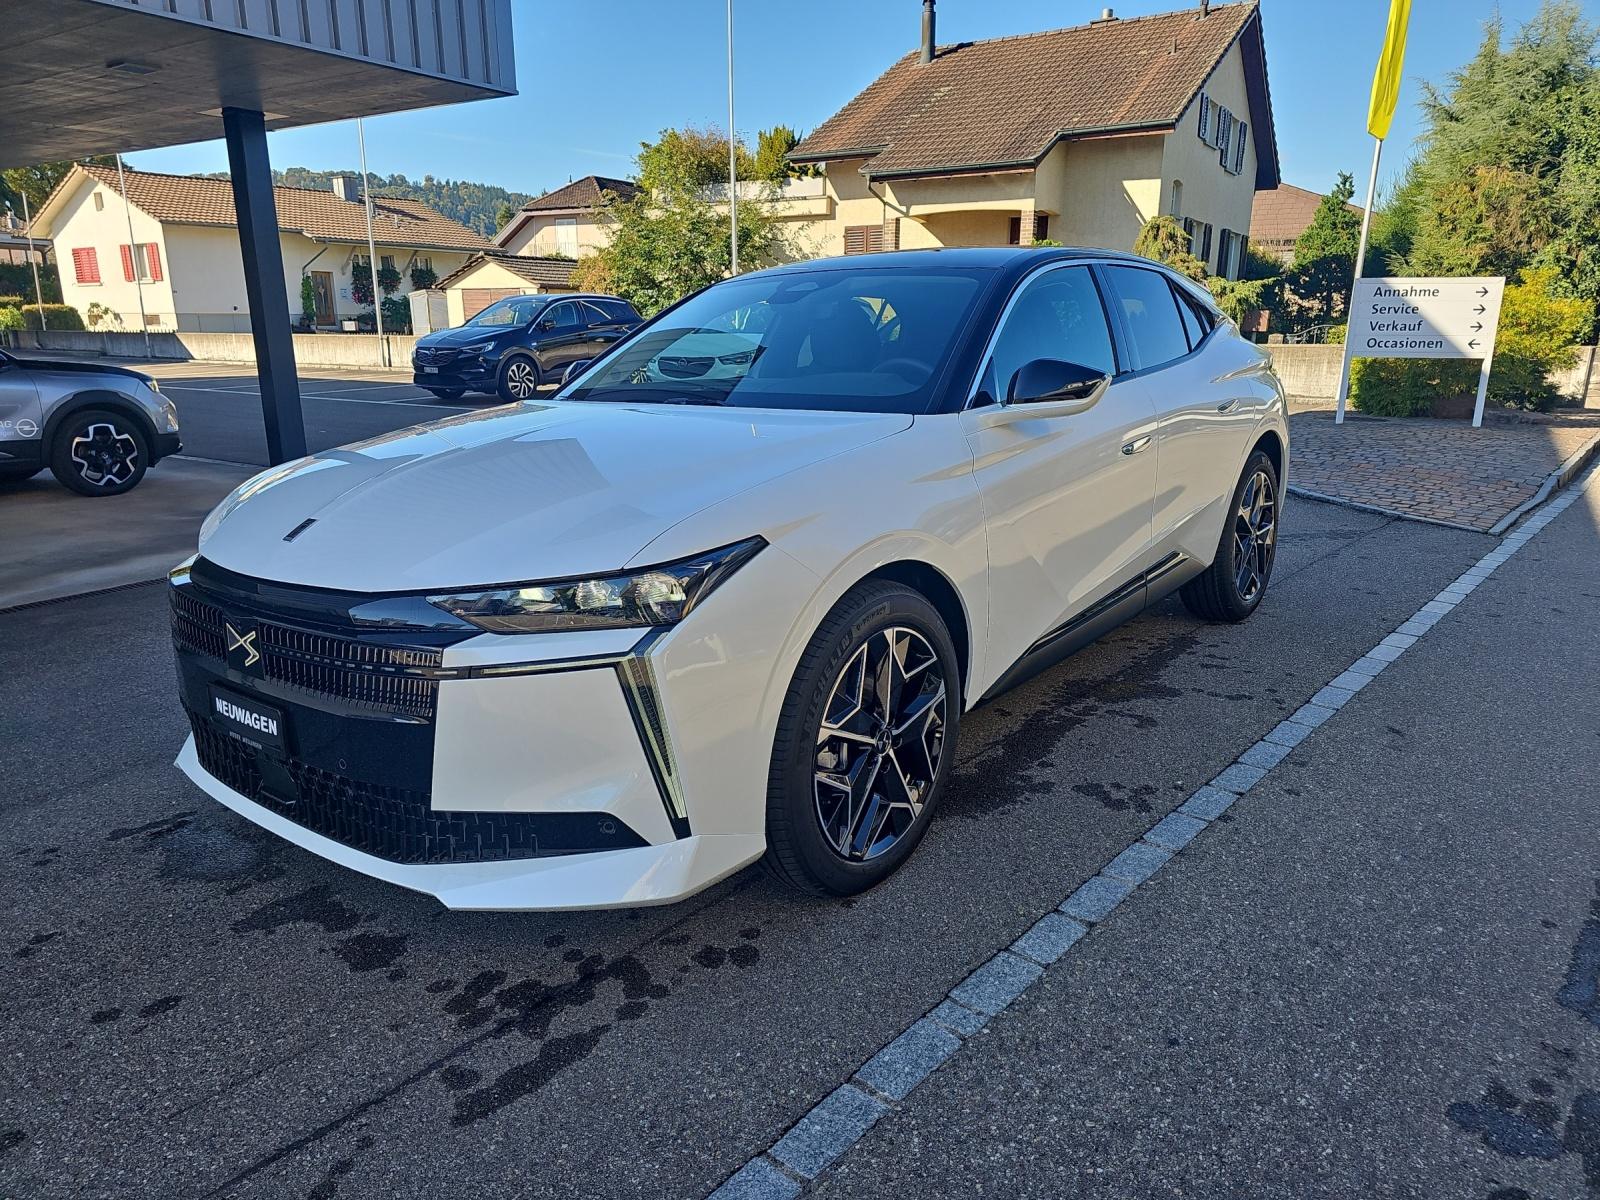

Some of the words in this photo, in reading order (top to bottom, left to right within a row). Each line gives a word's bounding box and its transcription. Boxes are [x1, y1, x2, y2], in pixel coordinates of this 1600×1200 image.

[1373, 286, 1440, 298] Annahme
[1371, 303, 1419, 315] Service
[1369, 320, 1423, 332] Verkauf
[1366, 337, 1443, 349] Occasionen
[215, 697, 278, 736] NEUWAGEN
